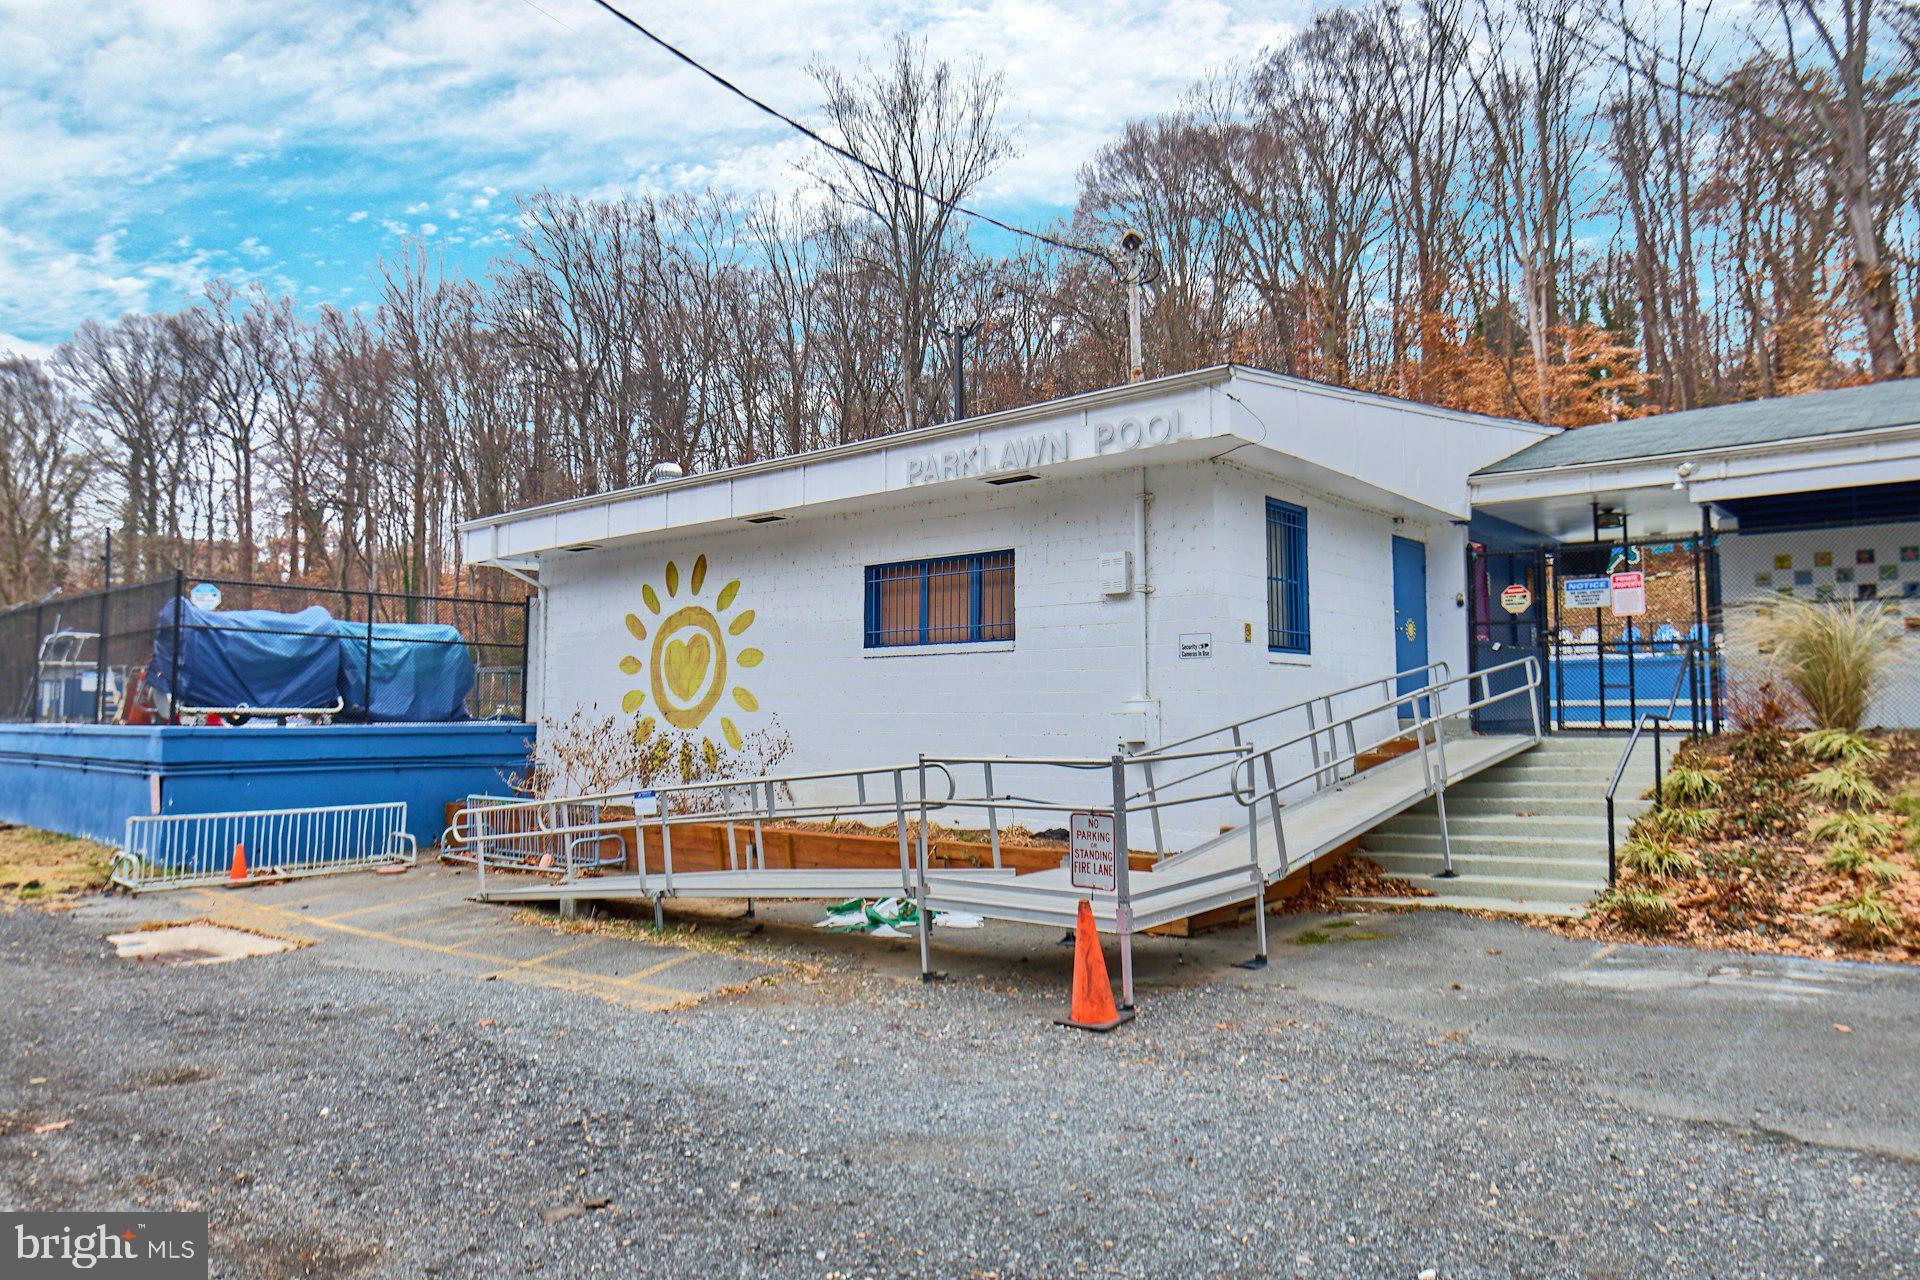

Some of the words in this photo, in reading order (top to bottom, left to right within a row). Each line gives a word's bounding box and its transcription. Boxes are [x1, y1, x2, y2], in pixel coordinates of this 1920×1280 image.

[905, 428, 1073, 486] PARKLAWN
[1094, 408, 1192, 455] POOL
[1568, 581, 1607, 590] NOTICE
[1181, 643, 1198, 651] Security
[1088, 818, 1099, 829] NO
[1076, 830, 1110, 843] PARKING
[1074, 849, 1113, 862] STANDING
[1074, 861, 1091, 874] FIRE
[1093, 863, 1113, 877] LANE
